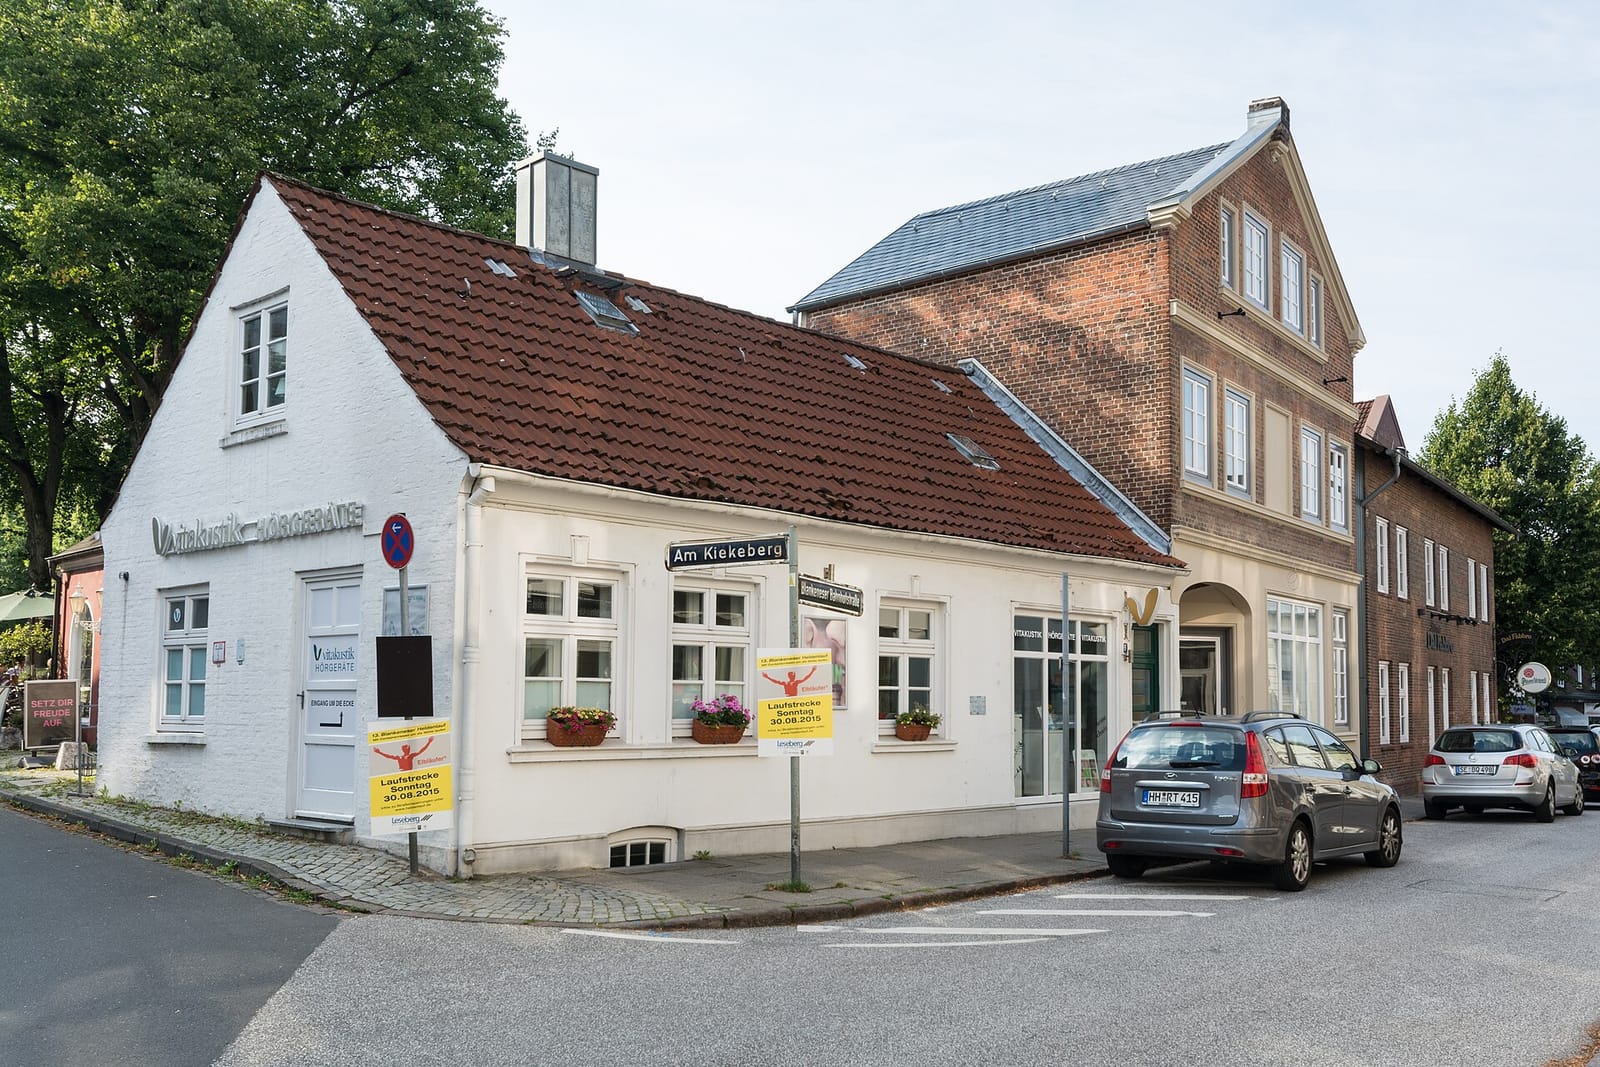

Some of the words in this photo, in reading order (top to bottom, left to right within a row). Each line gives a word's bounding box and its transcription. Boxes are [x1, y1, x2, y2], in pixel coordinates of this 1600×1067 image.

[256, 501, 364, 542] HÖRGERÄTE
[673, 548, 697, 563] Am
[704, 542, 783, 560] Kiekeberg
[1014, 629, 1042, 638] VITAKUSTIK
[315, 662, 355, 672] HÖRGERÄTE
[31, 699, 56, 708] SETZ
[58, 698, 73, 707] DIR
[767, 700, 821, 710] Laufstrecke
[33, 709, 71, 718] FREUDE
[776, 709, 814, 717] Sonntag
[43, 719, 62, 727] AUF
[770, 715, 821, 725] 30.08.2015
[380, 772, 439, 786] Laufstrecke
[390, 782, 431, 793] Sonntag
[383, 787, 440, 802] 30.08.2015
[1149, 791, 1161, 802] HH
[1166, 792, 1179, 803] RT
[1180, 793, 1199, 804] 415
